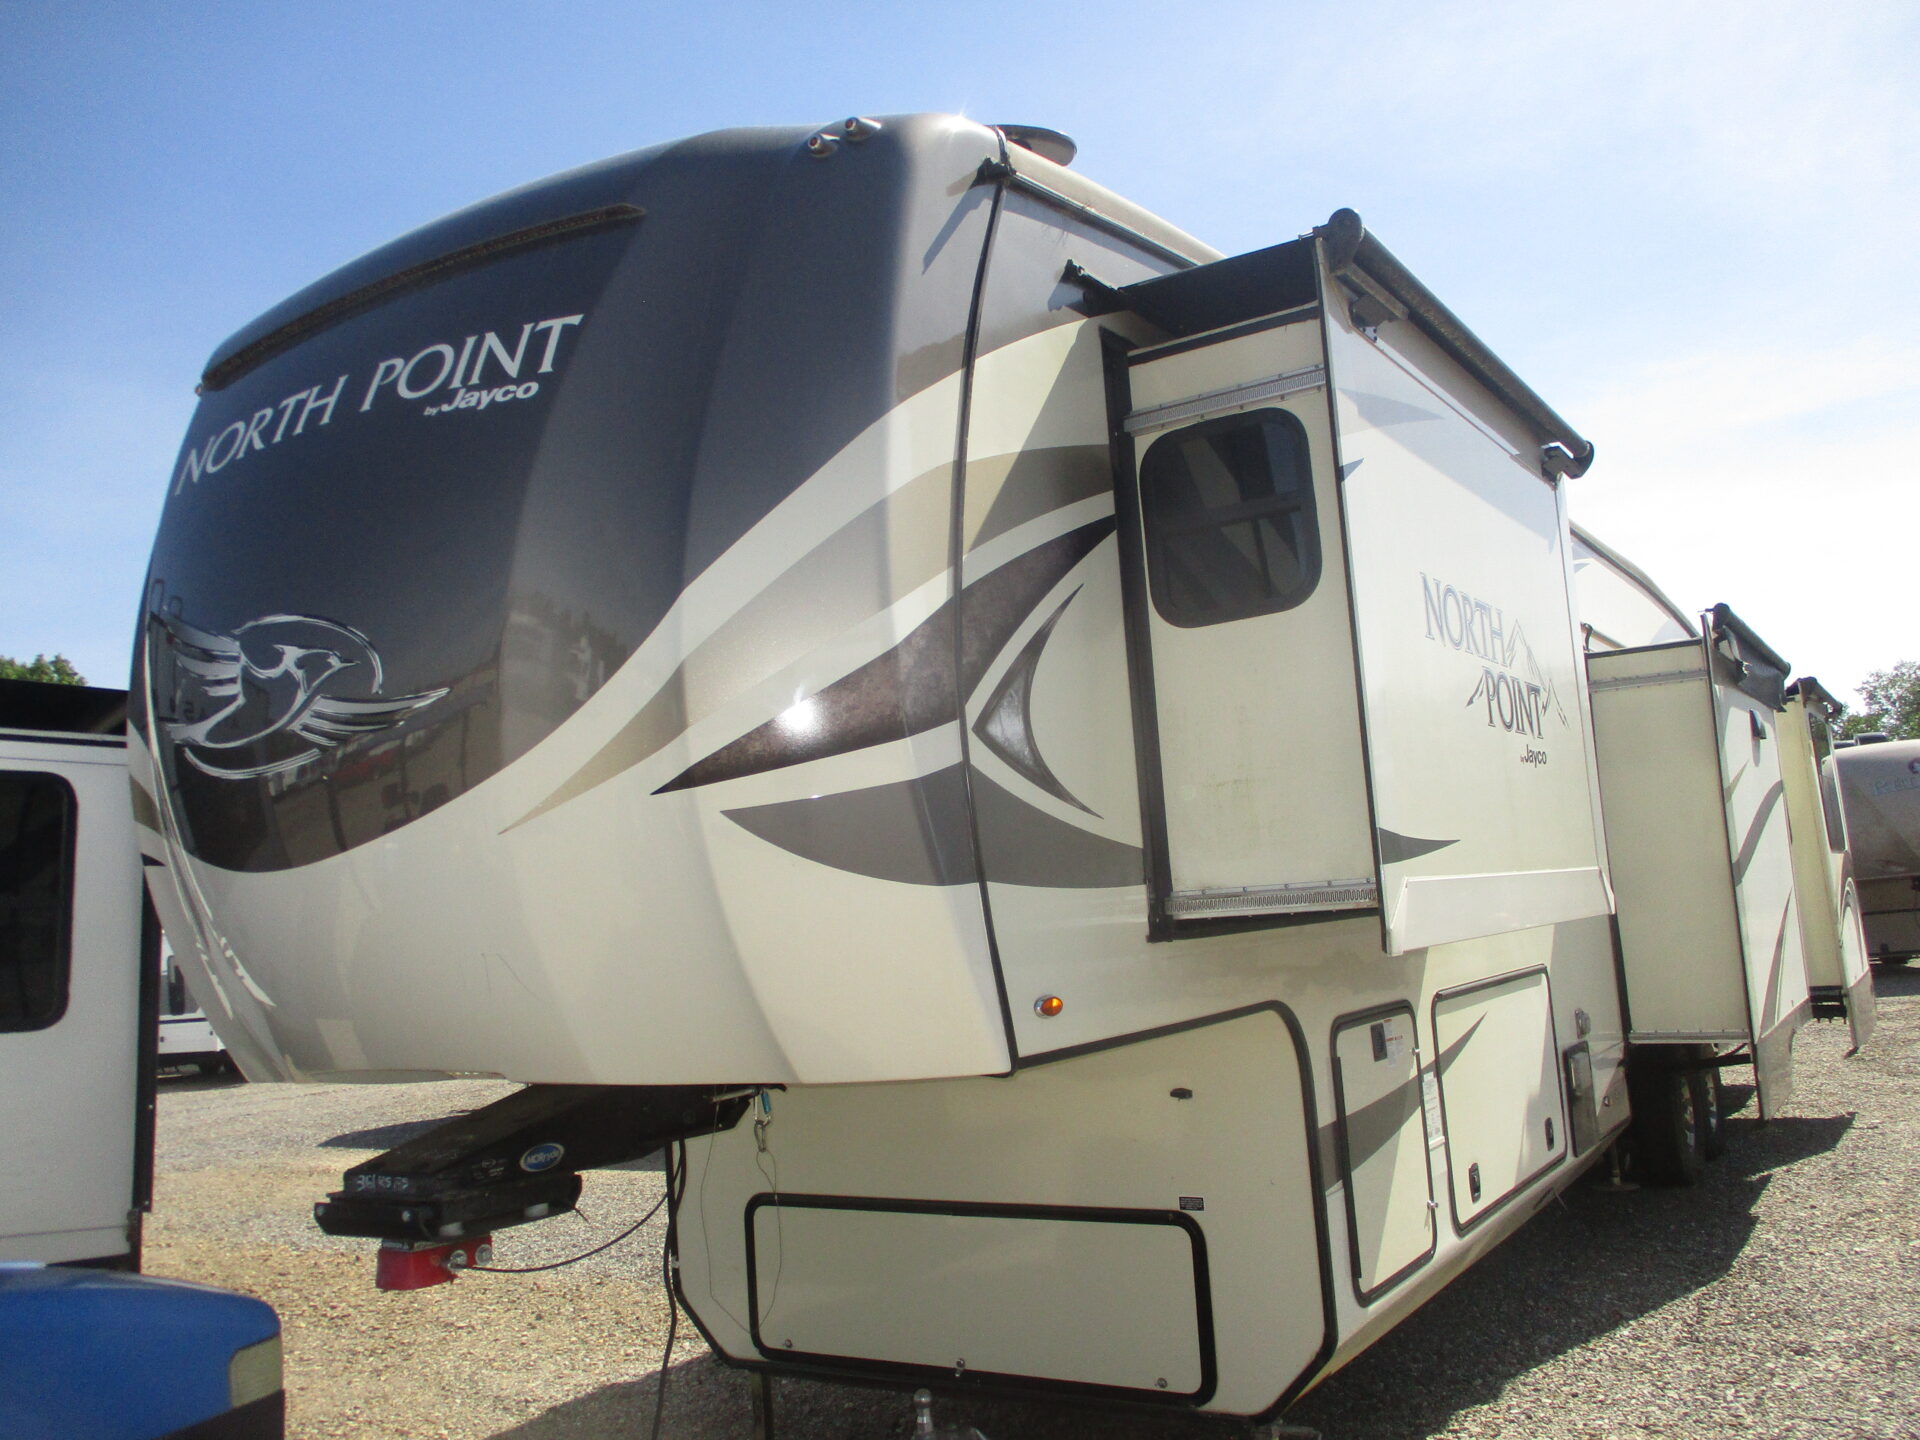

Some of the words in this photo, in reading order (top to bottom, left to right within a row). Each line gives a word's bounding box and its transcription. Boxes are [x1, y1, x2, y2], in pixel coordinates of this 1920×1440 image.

[174, 374, 349, 496] NORTH
[359, 313, 584, 412] POINT
[423, 406, 440, 416] by
[440, 381, 539, 410] Jayco
[1420, 571, 1508, 668] NORTH
[1482, 665, 1544, 740] POINT
[1524, 744, 1547, 768] Jayco
